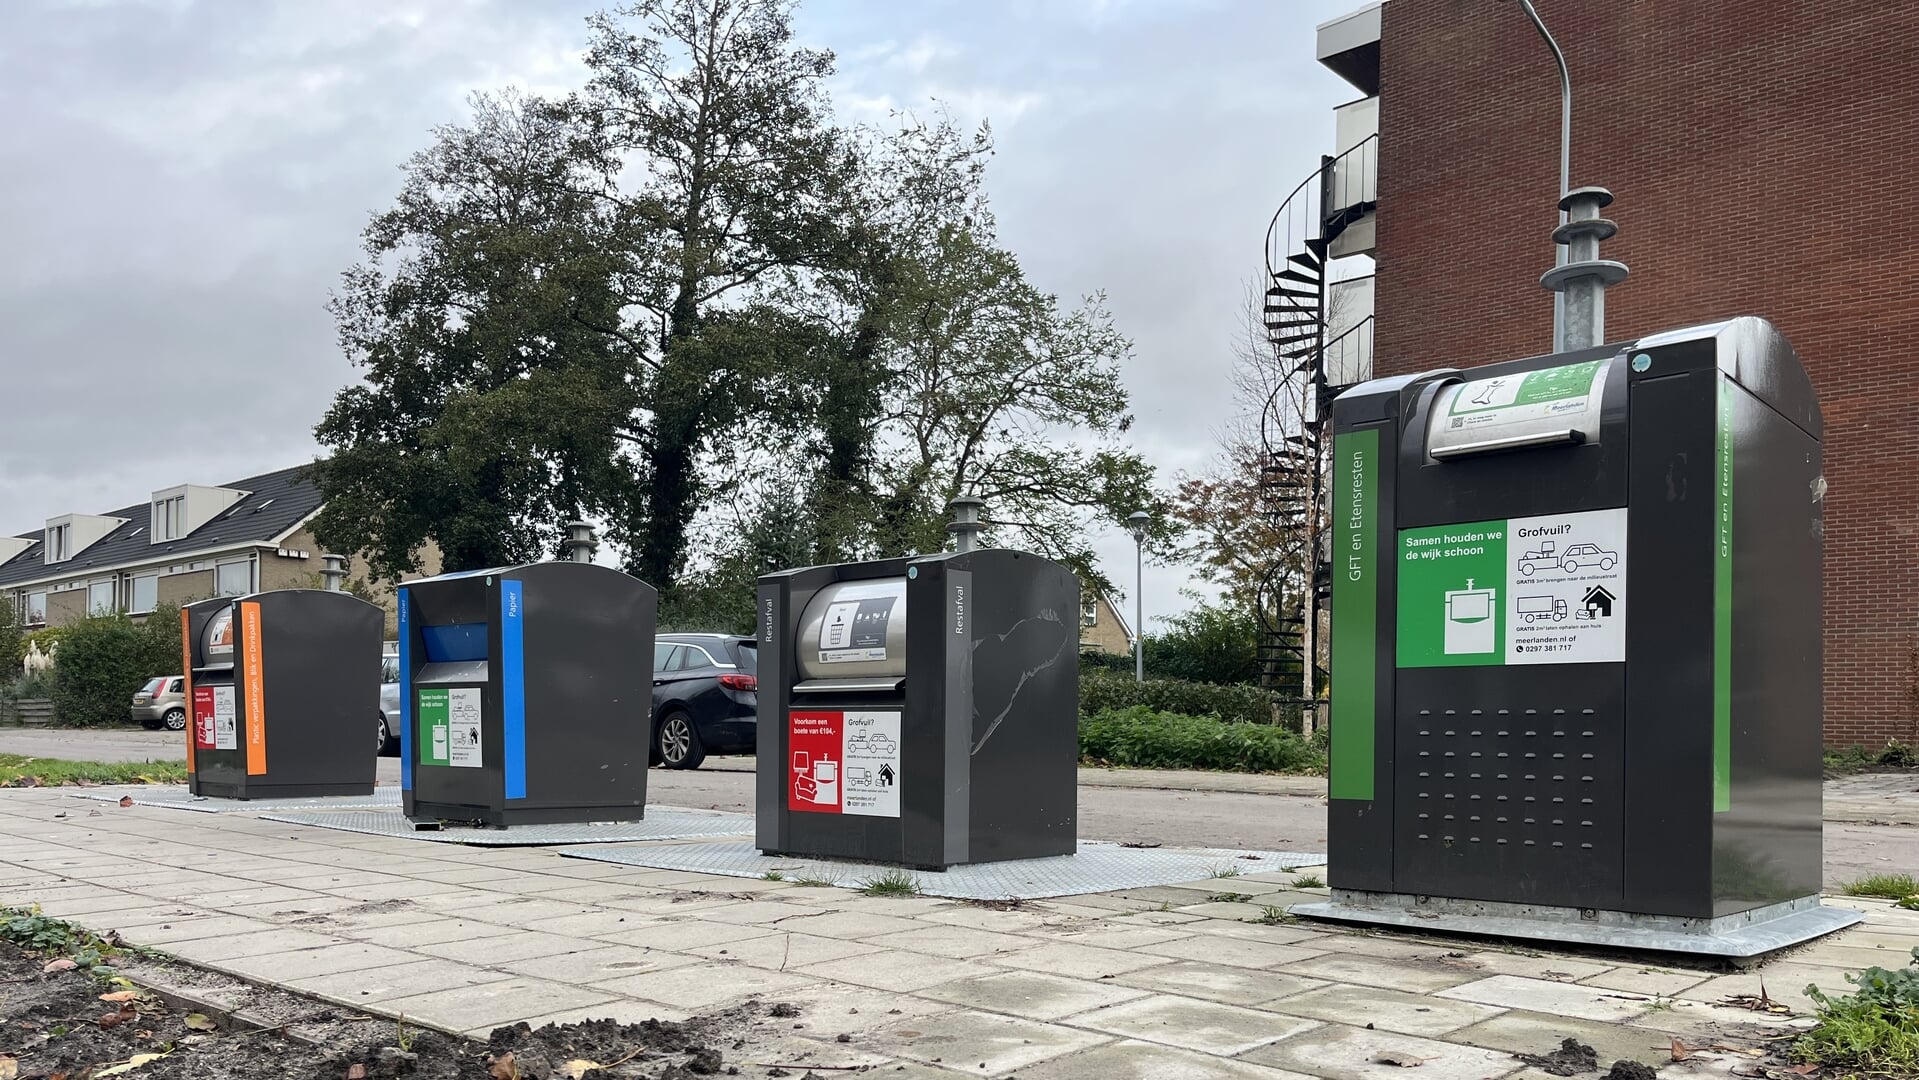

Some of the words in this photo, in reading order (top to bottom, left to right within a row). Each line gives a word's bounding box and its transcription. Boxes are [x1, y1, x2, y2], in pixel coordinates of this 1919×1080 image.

[1350, 450, 1363, 529] Etensresten
[1722, 502, 1728, 522] en
[1352, 533, 1362, 550] en
[1405, 536, 1442, 548] Samen
[1443, 531, 1484, 545] houden
[1486, 531, 1503, 541] we
[1518, 524, 1572, 539] Grofvuil?
[1721, 526, 1729, 558] GFT
[1405, 549, 1419, 561] de
[1421, 547, 1442, 561] wijk
[1444, 545, 1484, 558] schoon
[1349, 554, 1362, 582] GFT
[509, 592, 518, 617] Papier
[955, 585, 964, 634] Restafval
[765, 598, 773, 643] Restafval
[1515, 636, 1567, 645] meerlanden.nl
[1525, 645, 1542, 653] 0297
